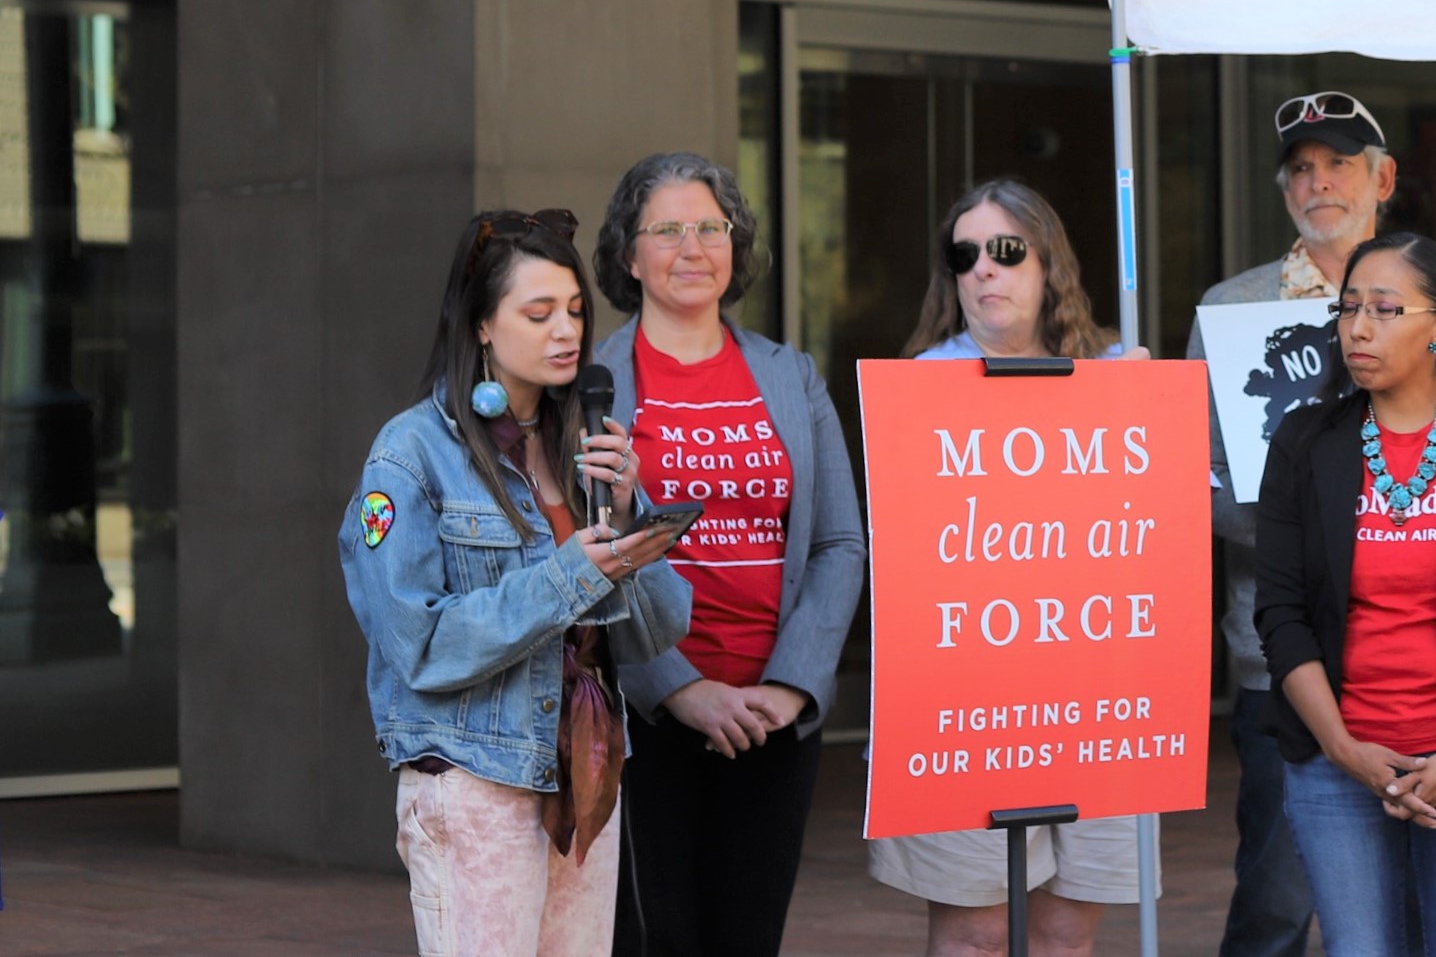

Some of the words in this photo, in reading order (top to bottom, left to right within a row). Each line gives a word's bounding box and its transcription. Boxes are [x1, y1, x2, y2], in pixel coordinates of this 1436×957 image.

[1281, 345, 1322, 382] NO
[658, 420, 774, 446] MOMS
[933, 426, 1150, 477] MOMS
[661, 446, 735, 470] clean
[745, 446, 784, 468] air
[661, 478, 789, 500] FORCE
[699, 533, 742, 546] KIDS'
[747, 531, 784, 544] HEAL
[938, 496, 1066, 564] clean
[1087, 502, 1155, 559] air
[1357, 527, 1407, 541] CLEAN
[935, 593, 1157, 649] FORCE
[938, 700, 1081, 734] FIGHTING
[1096, 697, 1152, 723] FOR
[908, 749, 970, 778] OUR
[984, 743, 1065, 772] KIDS'
[1077, 733, 1186, 764] HEALTH
